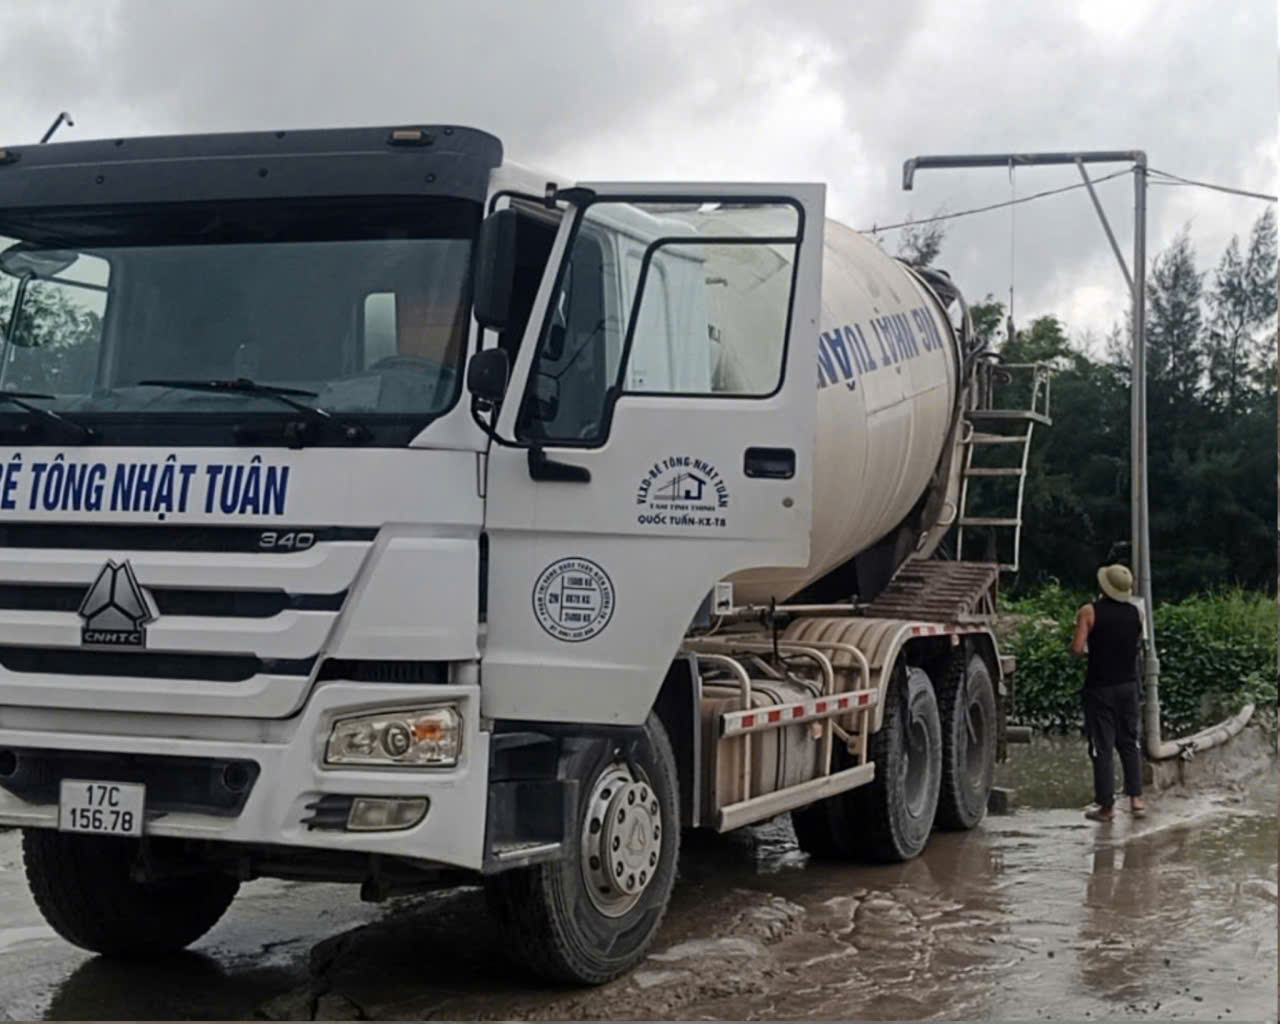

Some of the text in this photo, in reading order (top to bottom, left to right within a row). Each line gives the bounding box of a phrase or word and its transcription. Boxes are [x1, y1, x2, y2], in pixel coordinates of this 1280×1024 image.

[29, 453, 107, 511] TÔNG
[110, 454, 197, 520] NHẬT
[204, 455, 291, 515] TUÂN
[638, 511, 667, 525] QUỐC
[259, 531, 315, 548] 340
[84, 631, 140, 643] CNHTC
[85, 786, 120, 806] 17C
[69, 806, 133, 832] 156.78
